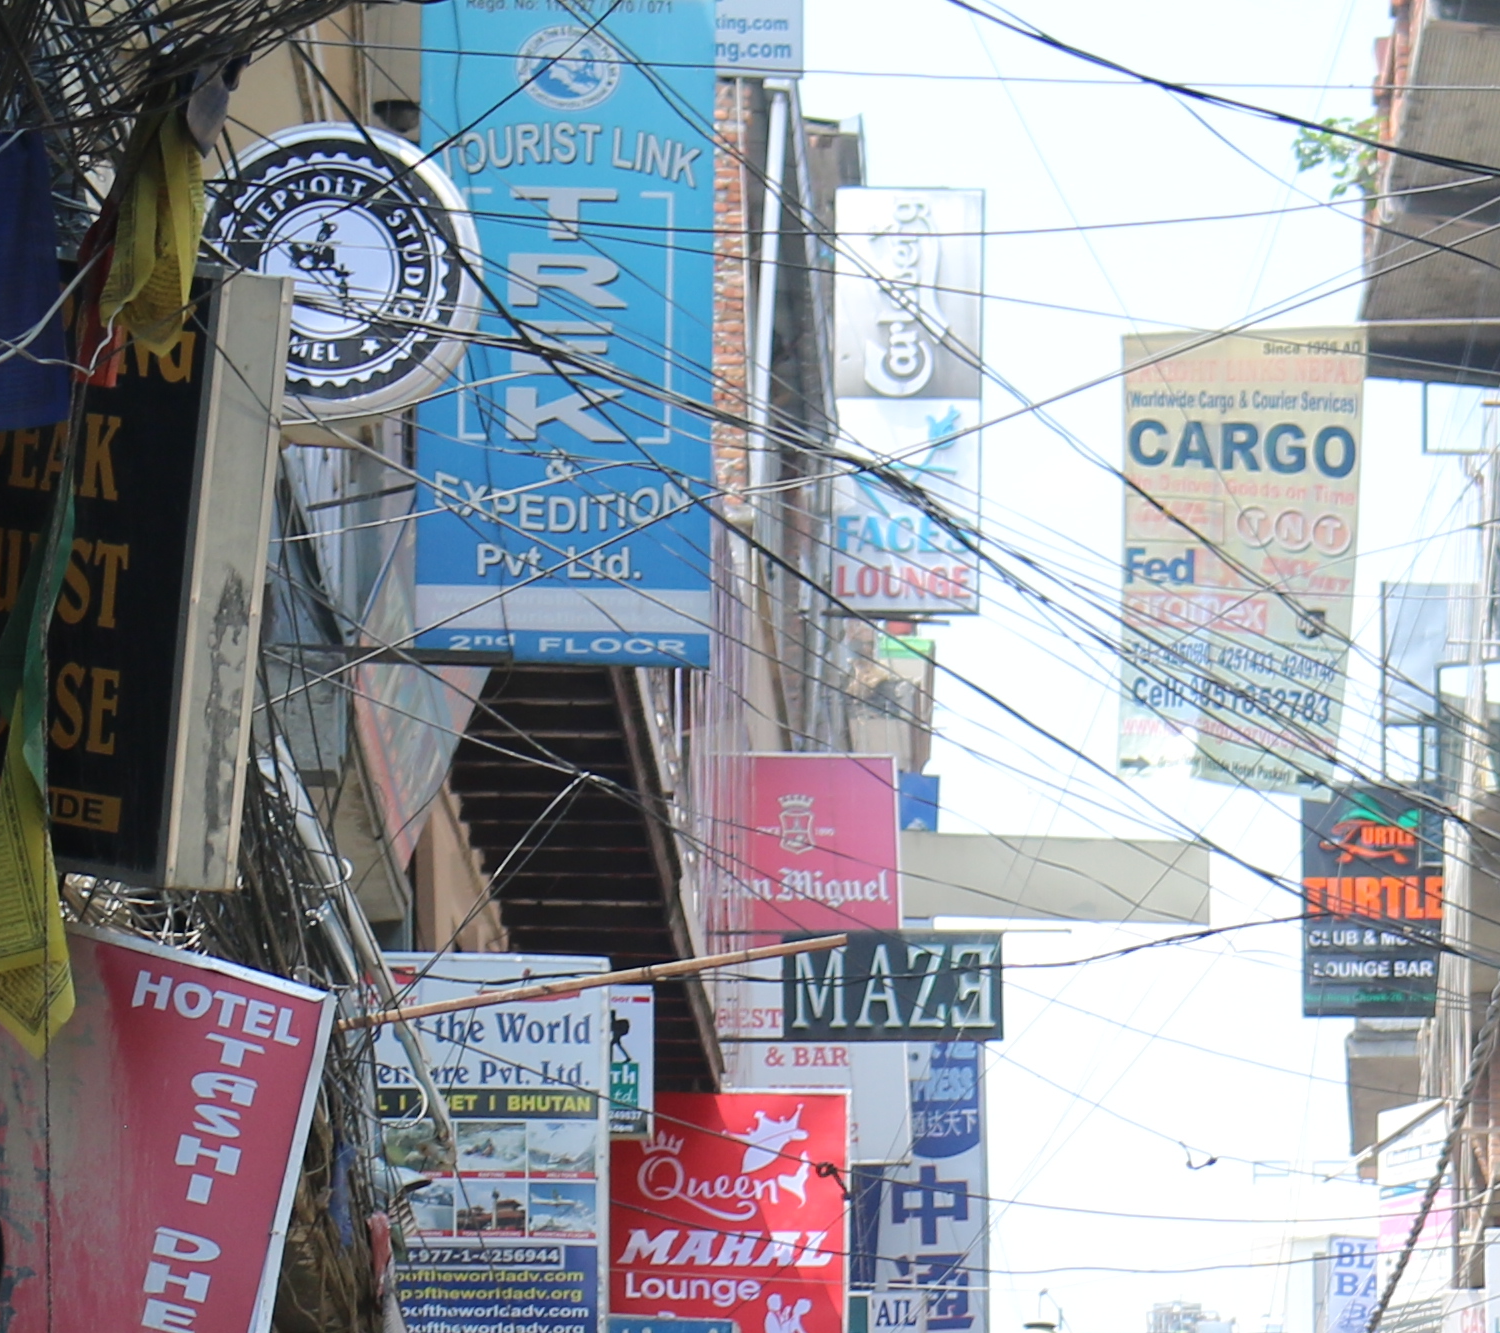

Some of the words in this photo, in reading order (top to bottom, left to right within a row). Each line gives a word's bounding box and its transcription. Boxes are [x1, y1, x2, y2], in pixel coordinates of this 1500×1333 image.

[434, 121, 602, 179] TOURIST
[611, 128, 701, 188] LINK
[1200, 393, 1234, 414] Cargo
[1253, 392, 1298, 410] Courier
[1301, 392, 1358, 416] Services)
[1128, 419, 1356, 479] CARGO
[434, 471, 691, 533] EXPEDITION
[567, 547, 642, 580] Ltd.
[836, 566, 971, 599] LOUNGE
[450, 634, 516, 651] 2nd
[539, 638, 687, 655] FLOOR
[776, 868, 889, 908] Miguel
[1302, 877, 1444, 920] TURTLE
[1309, 930, 1358, 946] CLUB
[1363, 930, 1376, 945] &
[1314, 961, 1389, 978] LOUNGE
[1394, 960, 1433, 977] BAR
[132, 969, 301, 1047] HOTEL
[495, 1013, 592, 1044] World
[480, 1061, 529, 1083] Pvt.
[541, 1061, 588, 1084] Ltd.
[765, 1048, 784, 1066] &
[793, 1047, 849, 1066] BAR
[507, 1096, 591, 1111] BHUTAN
[637, 1156, 779, 1220] Queen
[618, 1229, 834, 1267] MAHAL
[625, 1273, 761, 1307] Lounge
